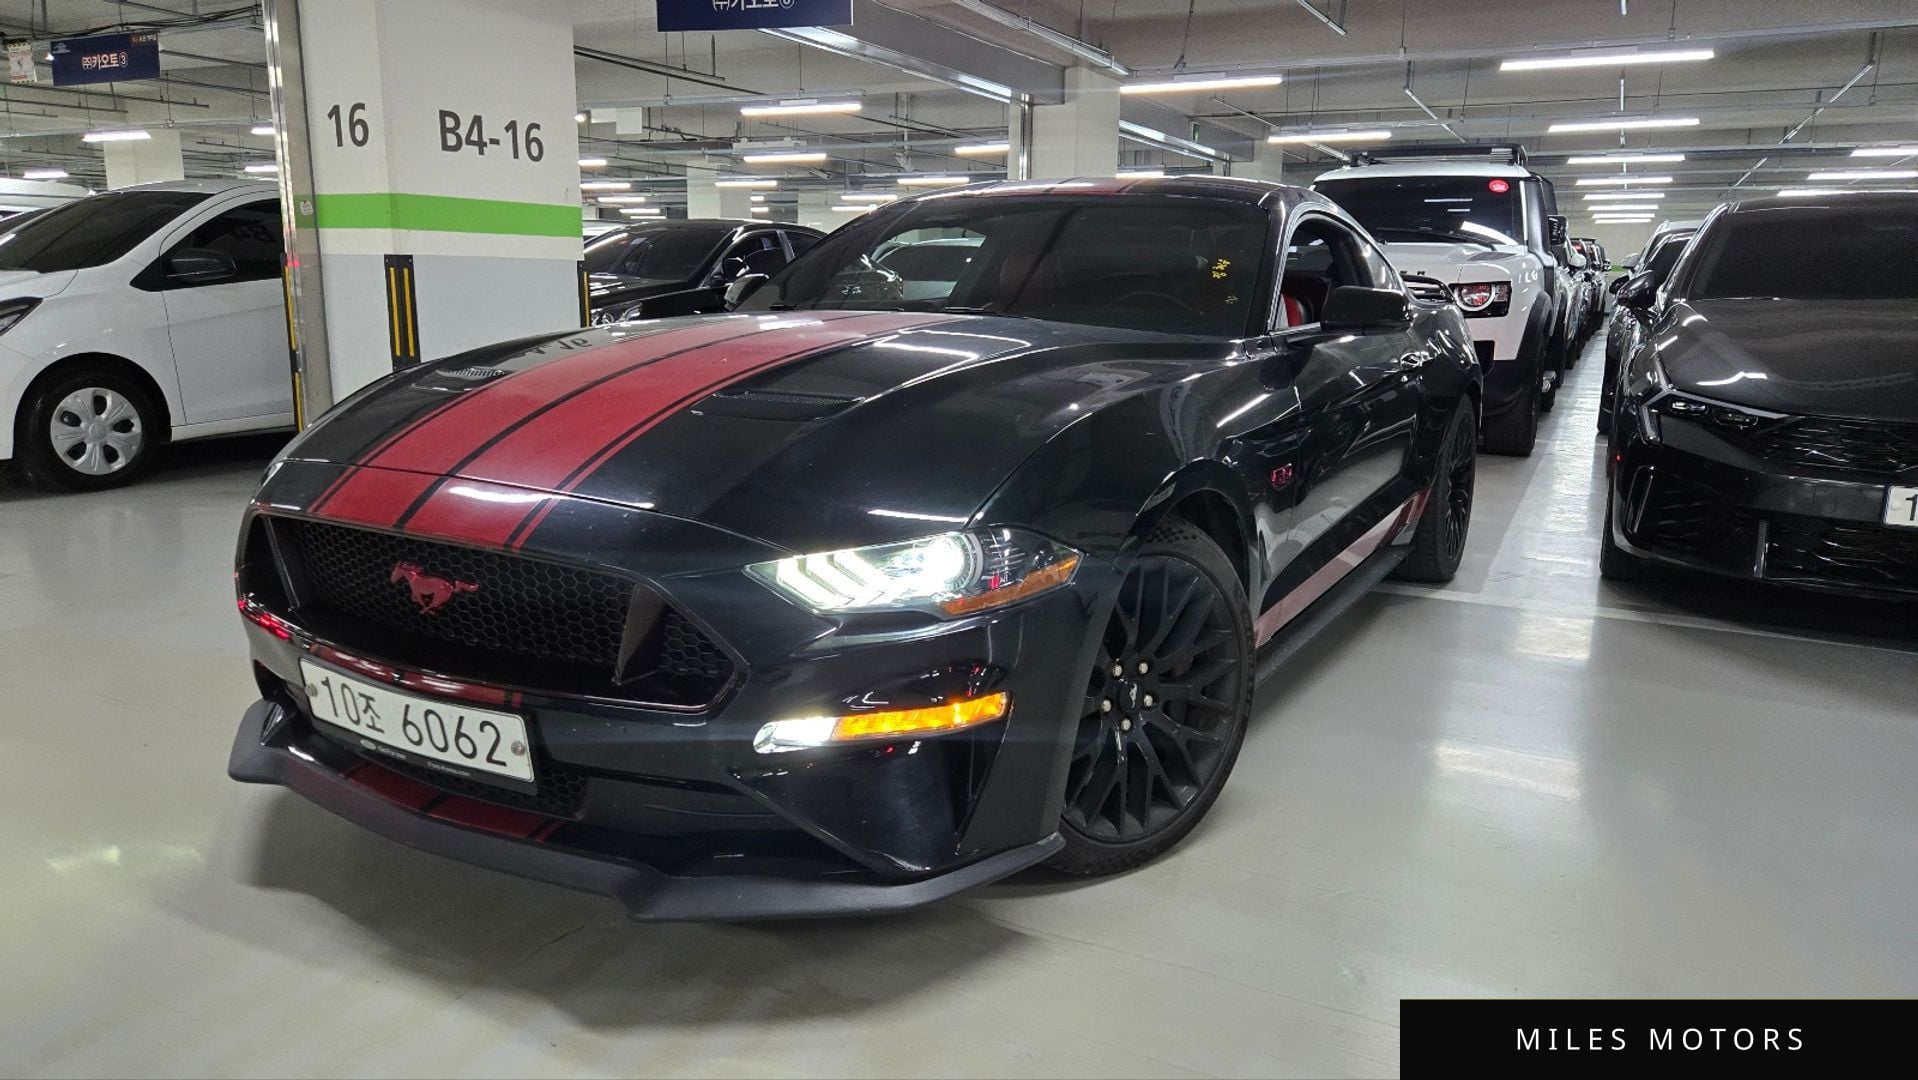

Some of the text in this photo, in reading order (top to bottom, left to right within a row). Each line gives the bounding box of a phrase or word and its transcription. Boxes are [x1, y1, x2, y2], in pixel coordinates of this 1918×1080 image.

[327, 102, 369, 147] 16
[438, 109, 544, 162] B4-16
[1905, 494, 1918, 521] 1
[321, 676, 507, 767] 10조 6062
